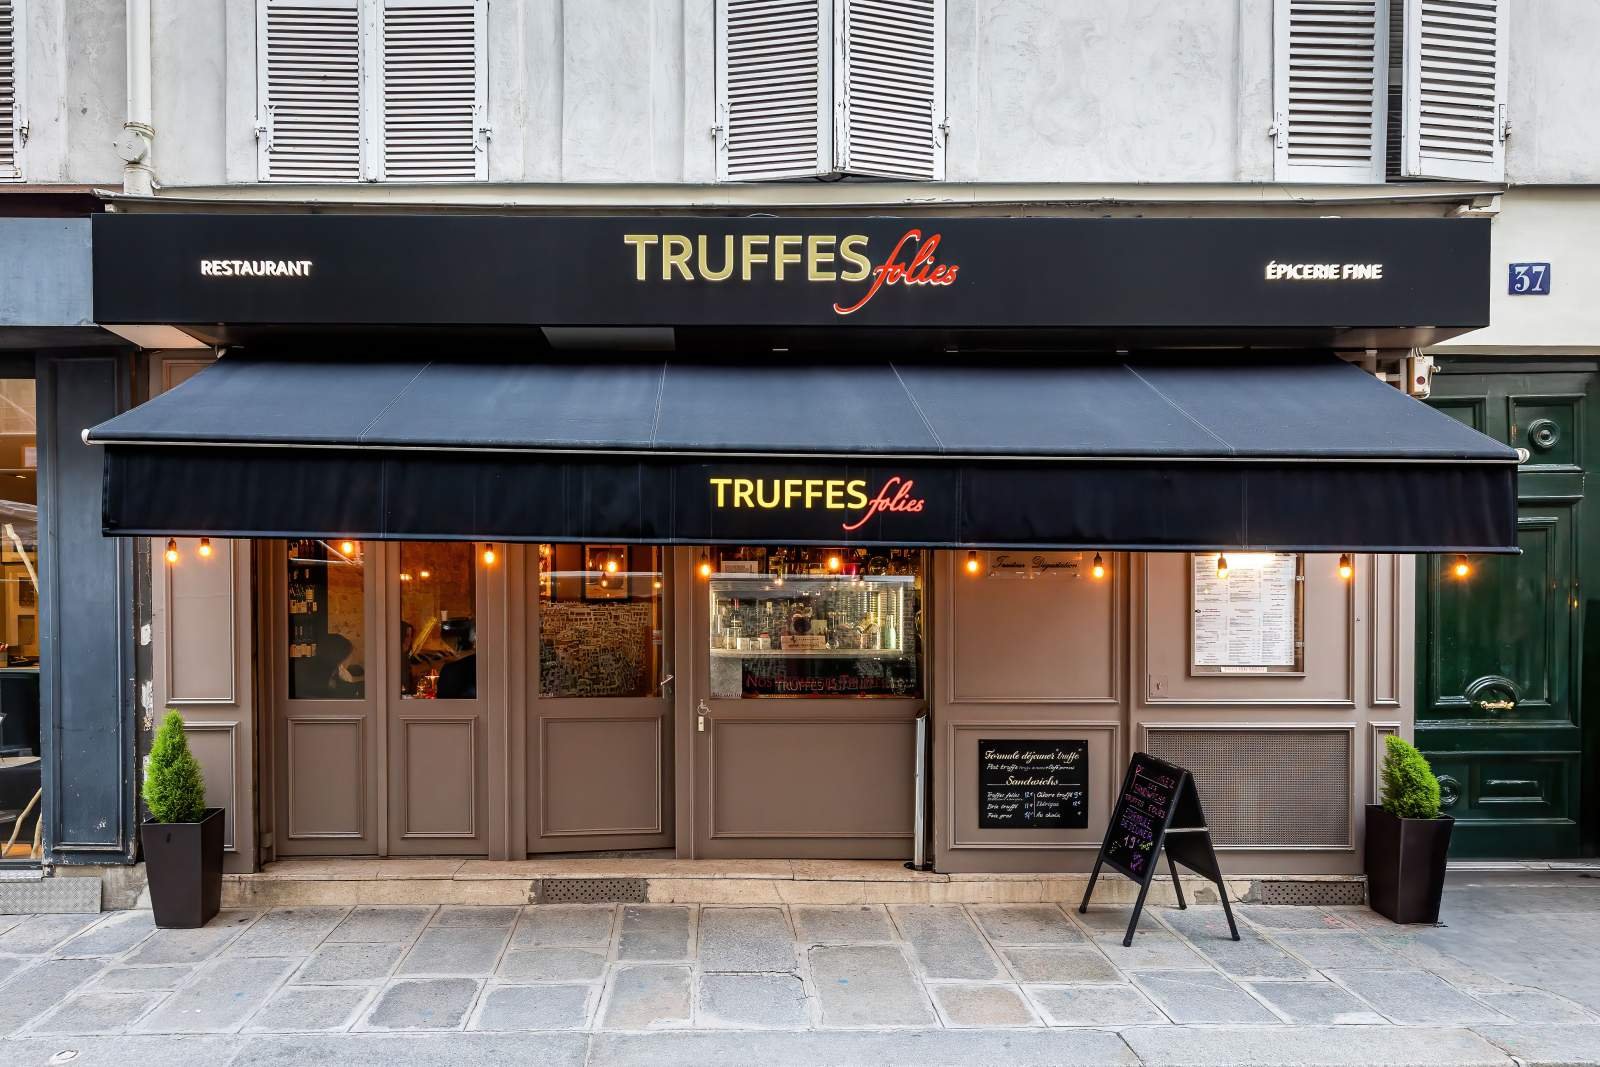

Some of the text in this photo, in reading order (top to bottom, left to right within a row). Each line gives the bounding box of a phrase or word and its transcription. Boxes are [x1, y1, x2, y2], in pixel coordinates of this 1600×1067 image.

[200, 260, 313, 277] RESTAURANT
[623, 229, 960, 315] TRUFFES folies
[1265, 260, 1384, 280] ÉPICERIE FINE
[1514, 265, 1546, 292] 37
[709, 476, 926, 531] TRUFFES folies
[984, 749, 1020, 760] Formule
[1006, 775, 1059, 787] Sandwichs
